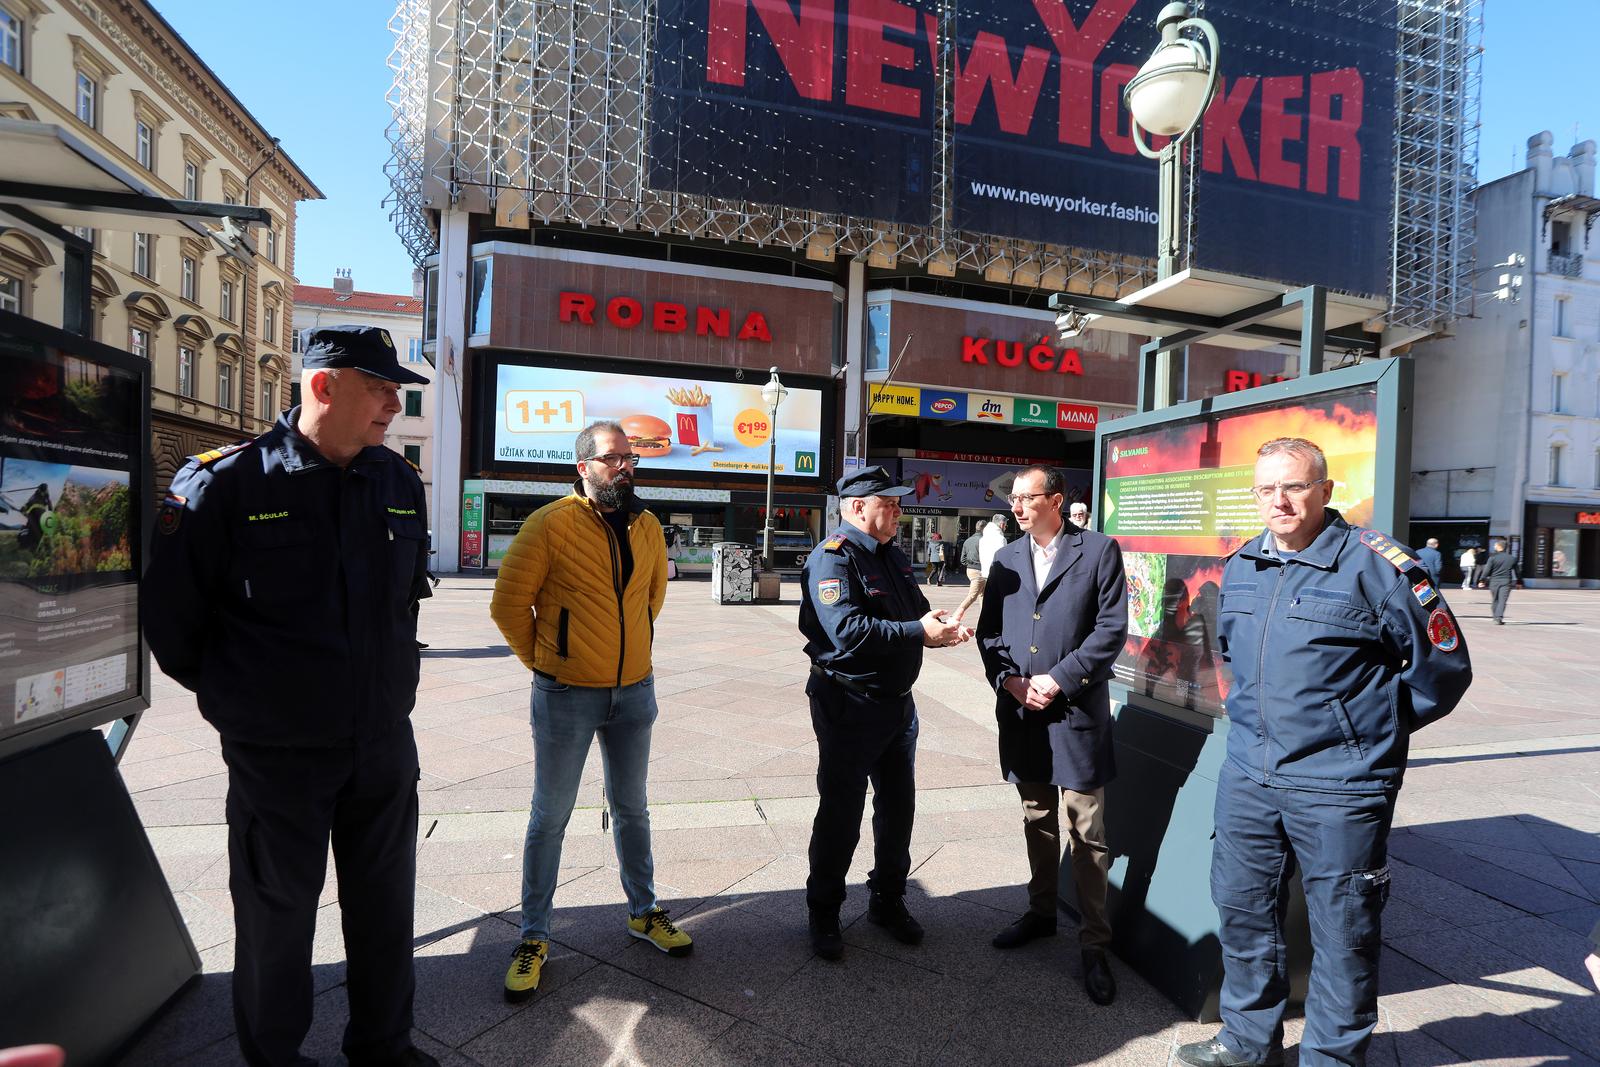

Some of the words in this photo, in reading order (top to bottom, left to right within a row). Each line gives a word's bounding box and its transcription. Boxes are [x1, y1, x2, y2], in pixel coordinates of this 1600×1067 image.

[970, 179, 1160, 225] www.newyorker.fashio
[558, 291, 773, 342] ROBNA
[962, 336, 1085, 376] KUĆA
[873, 393, 895, 404] HAPPY
[896, 396, 917, 406] HOME.
[982, 400, 1001, 413] dm
[515, 400, 574, 425] 1+1
[1061, 410, 1096, 424] MANA
[500, 446, 525, 458] UŽITAK
[527, 449, 544, 459] KOJI
[546, 450, 574, 461] VRIJEDI
[1119, 446, 1149, 457] SILVANUS
[953, 454, 1001, 464] AUTOMAT
[1005, 457, 1030, 465] CLUB
